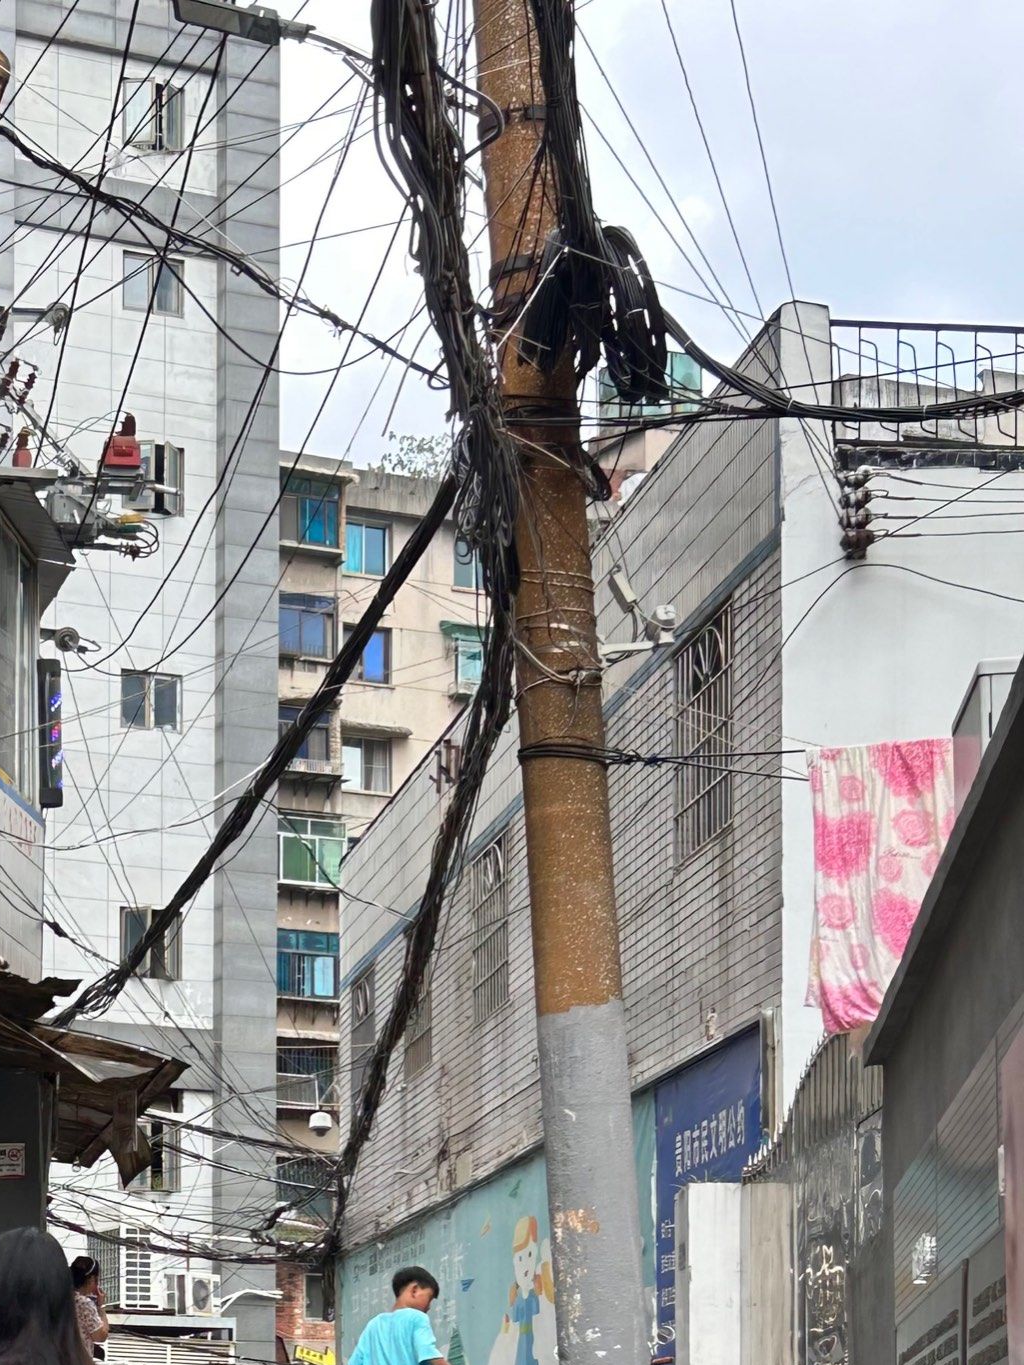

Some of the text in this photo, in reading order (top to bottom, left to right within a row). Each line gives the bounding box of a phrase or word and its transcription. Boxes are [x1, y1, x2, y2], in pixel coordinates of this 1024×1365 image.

[675, 1098, 745, 1178] 贵阳市民文明公约
